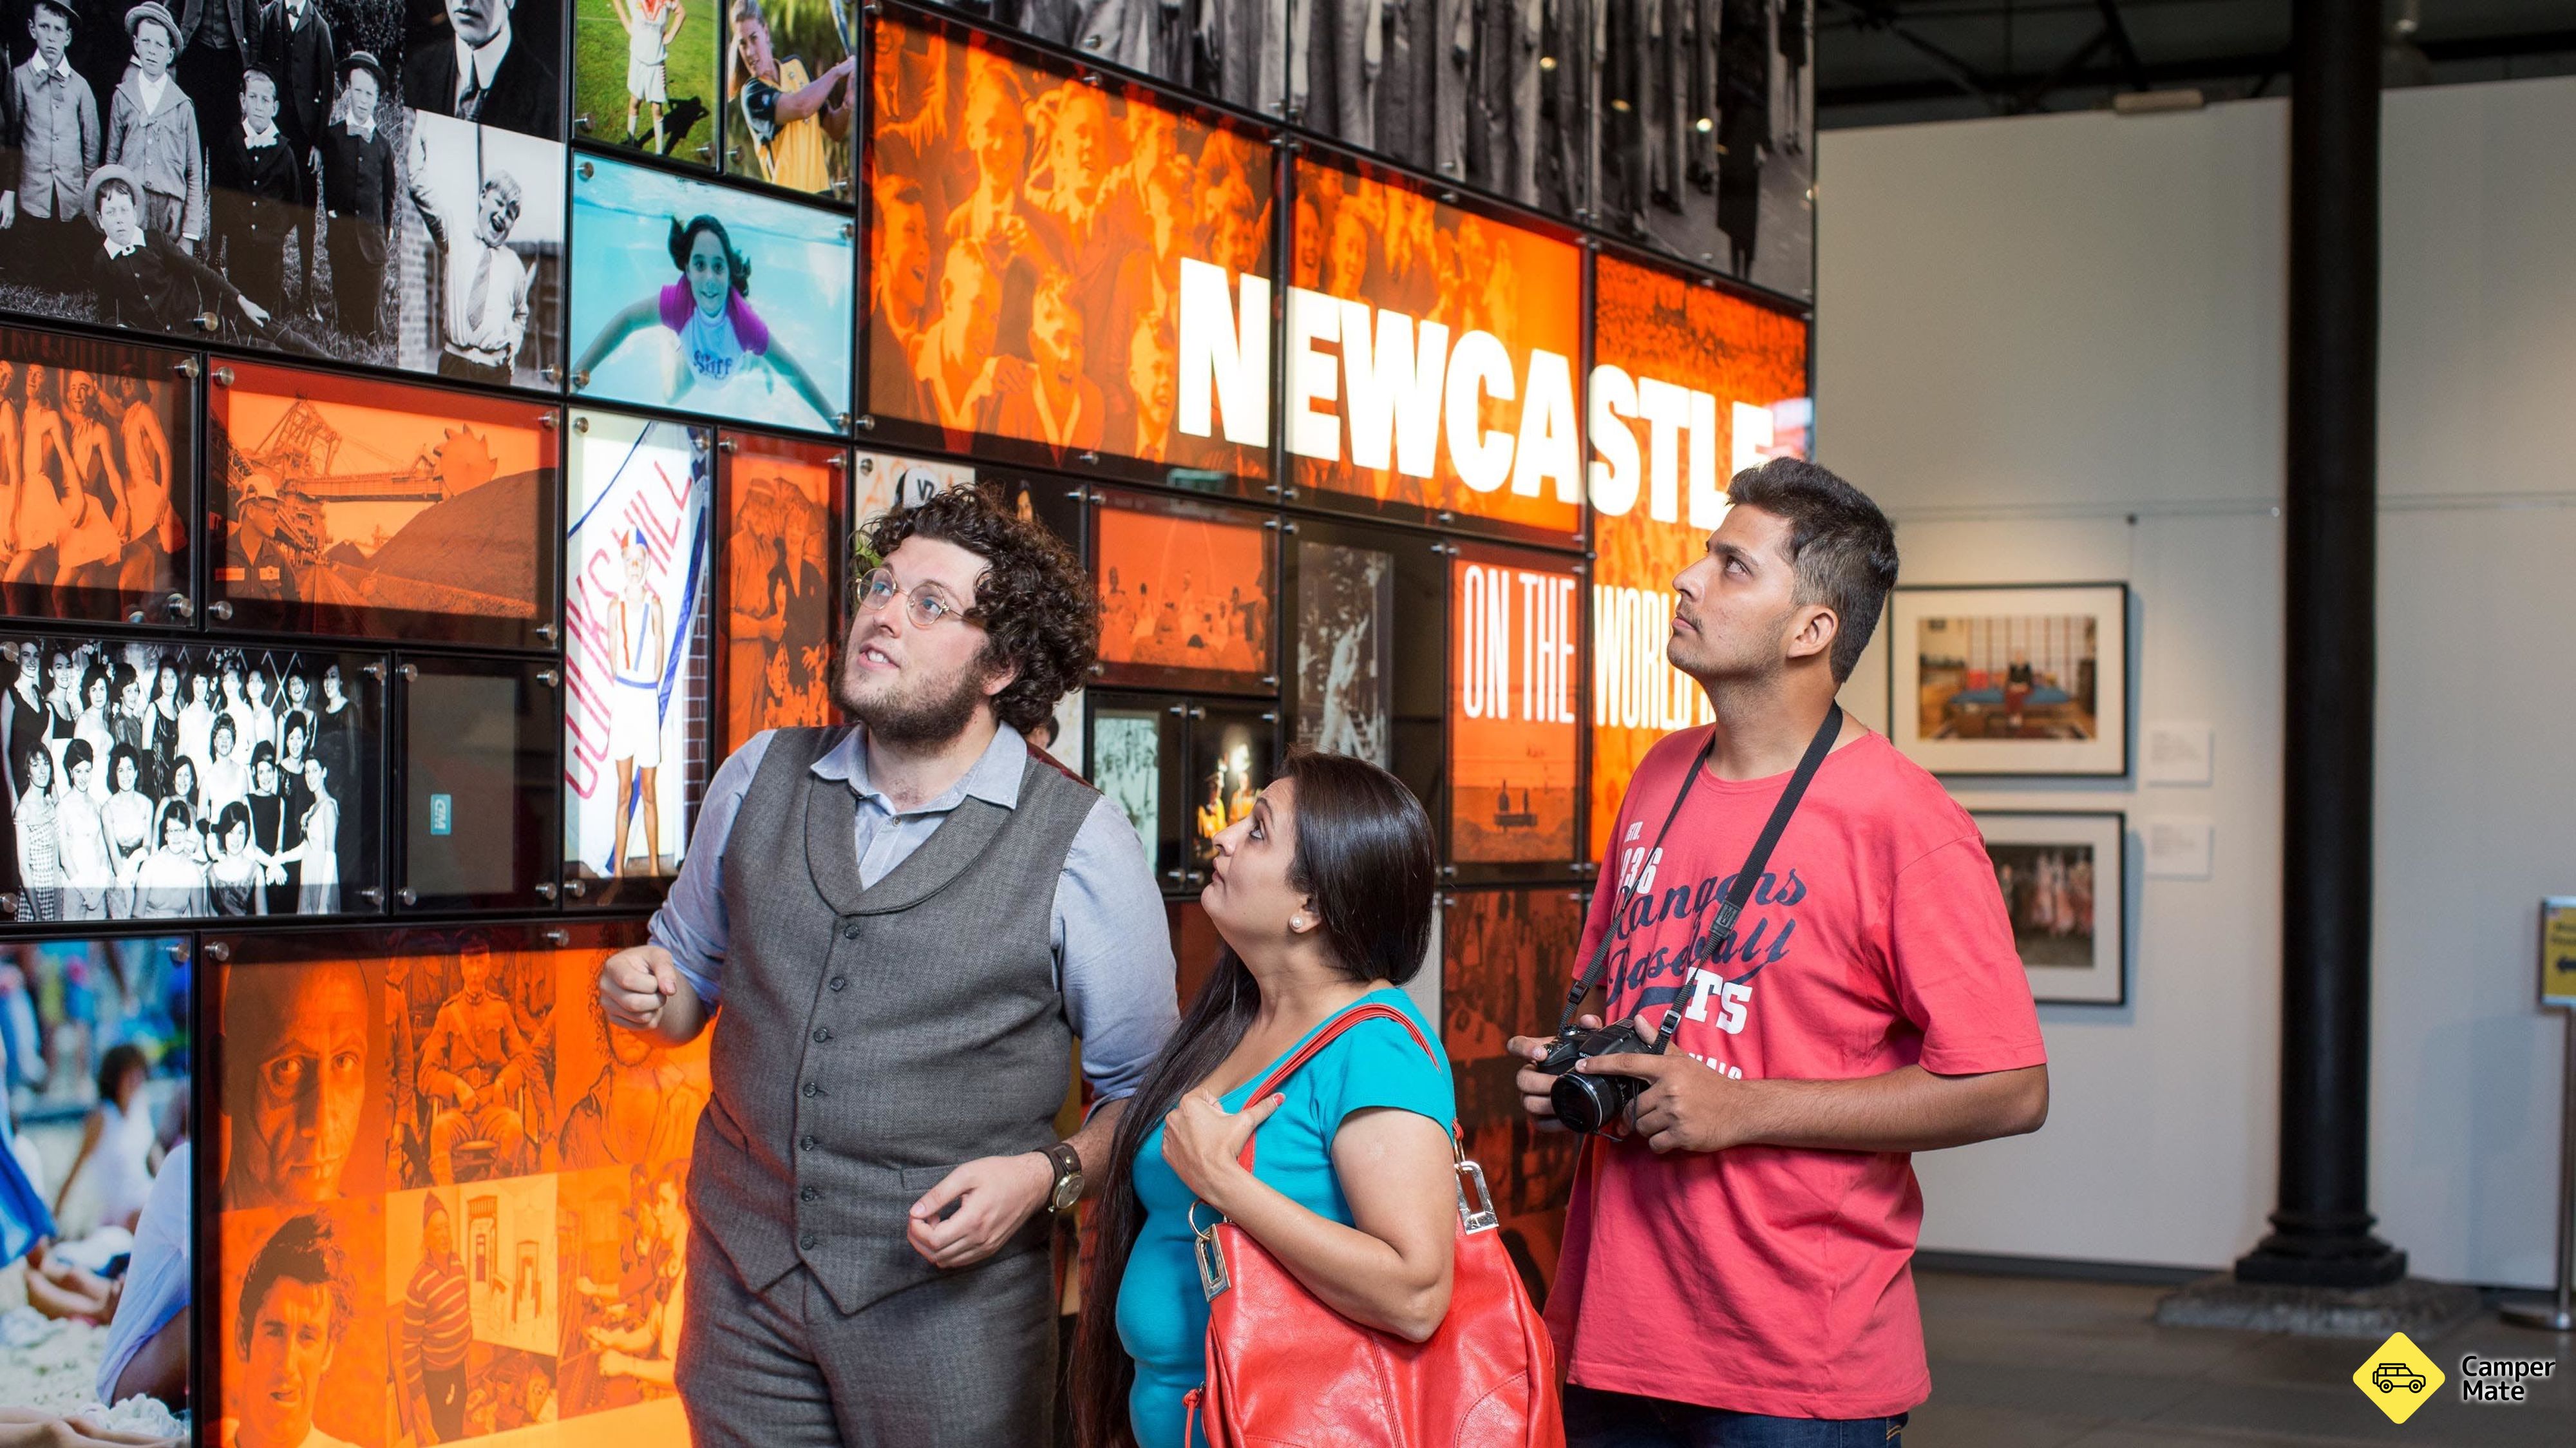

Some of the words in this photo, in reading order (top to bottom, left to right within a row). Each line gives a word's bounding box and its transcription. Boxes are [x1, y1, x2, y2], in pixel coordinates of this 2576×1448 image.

[1178, 256, 1775, 531] NEWCASTLE
[1463, 565, 1510, 720] ON
[1518, 572, 1576, 724] THE
[1618, 846, 1663, 895] 936
